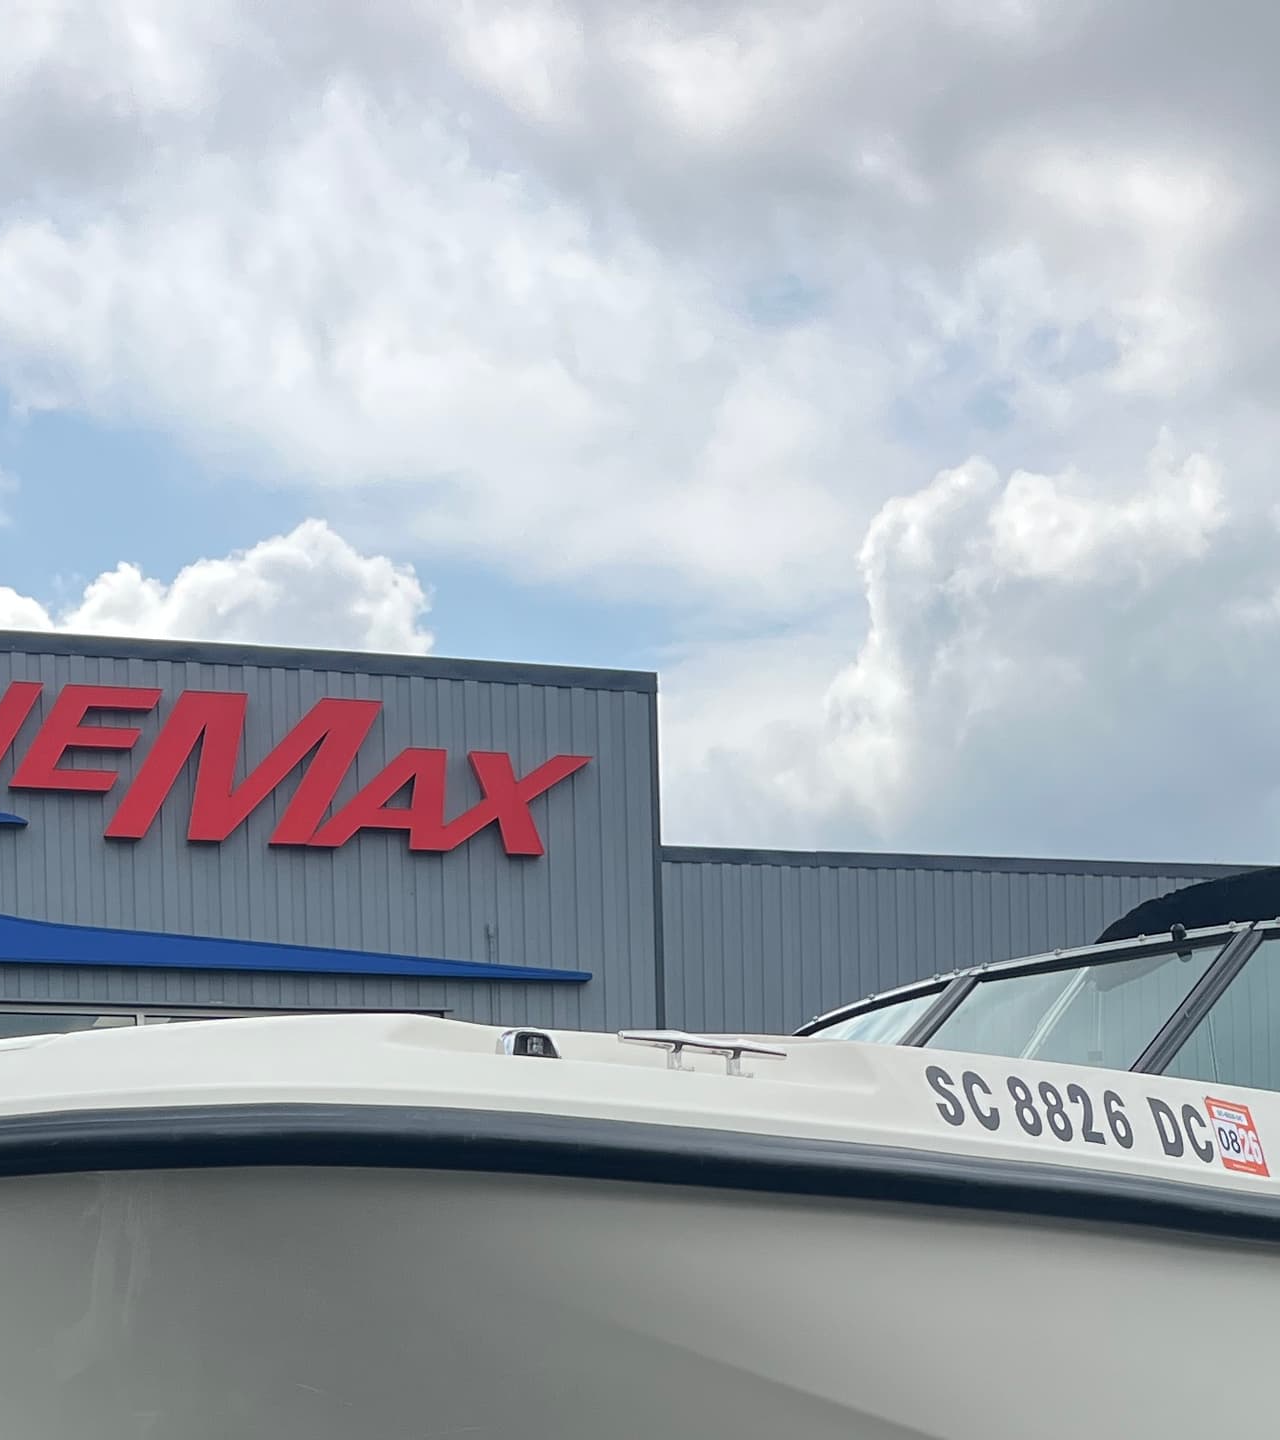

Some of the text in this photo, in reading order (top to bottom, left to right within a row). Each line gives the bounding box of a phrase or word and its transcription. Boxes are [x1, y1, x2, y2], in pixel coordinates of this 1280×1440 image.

[925, 1065, 1215, 1164] SC 8826 DC
[1217, 1126, 1263, 1165] 08 26
